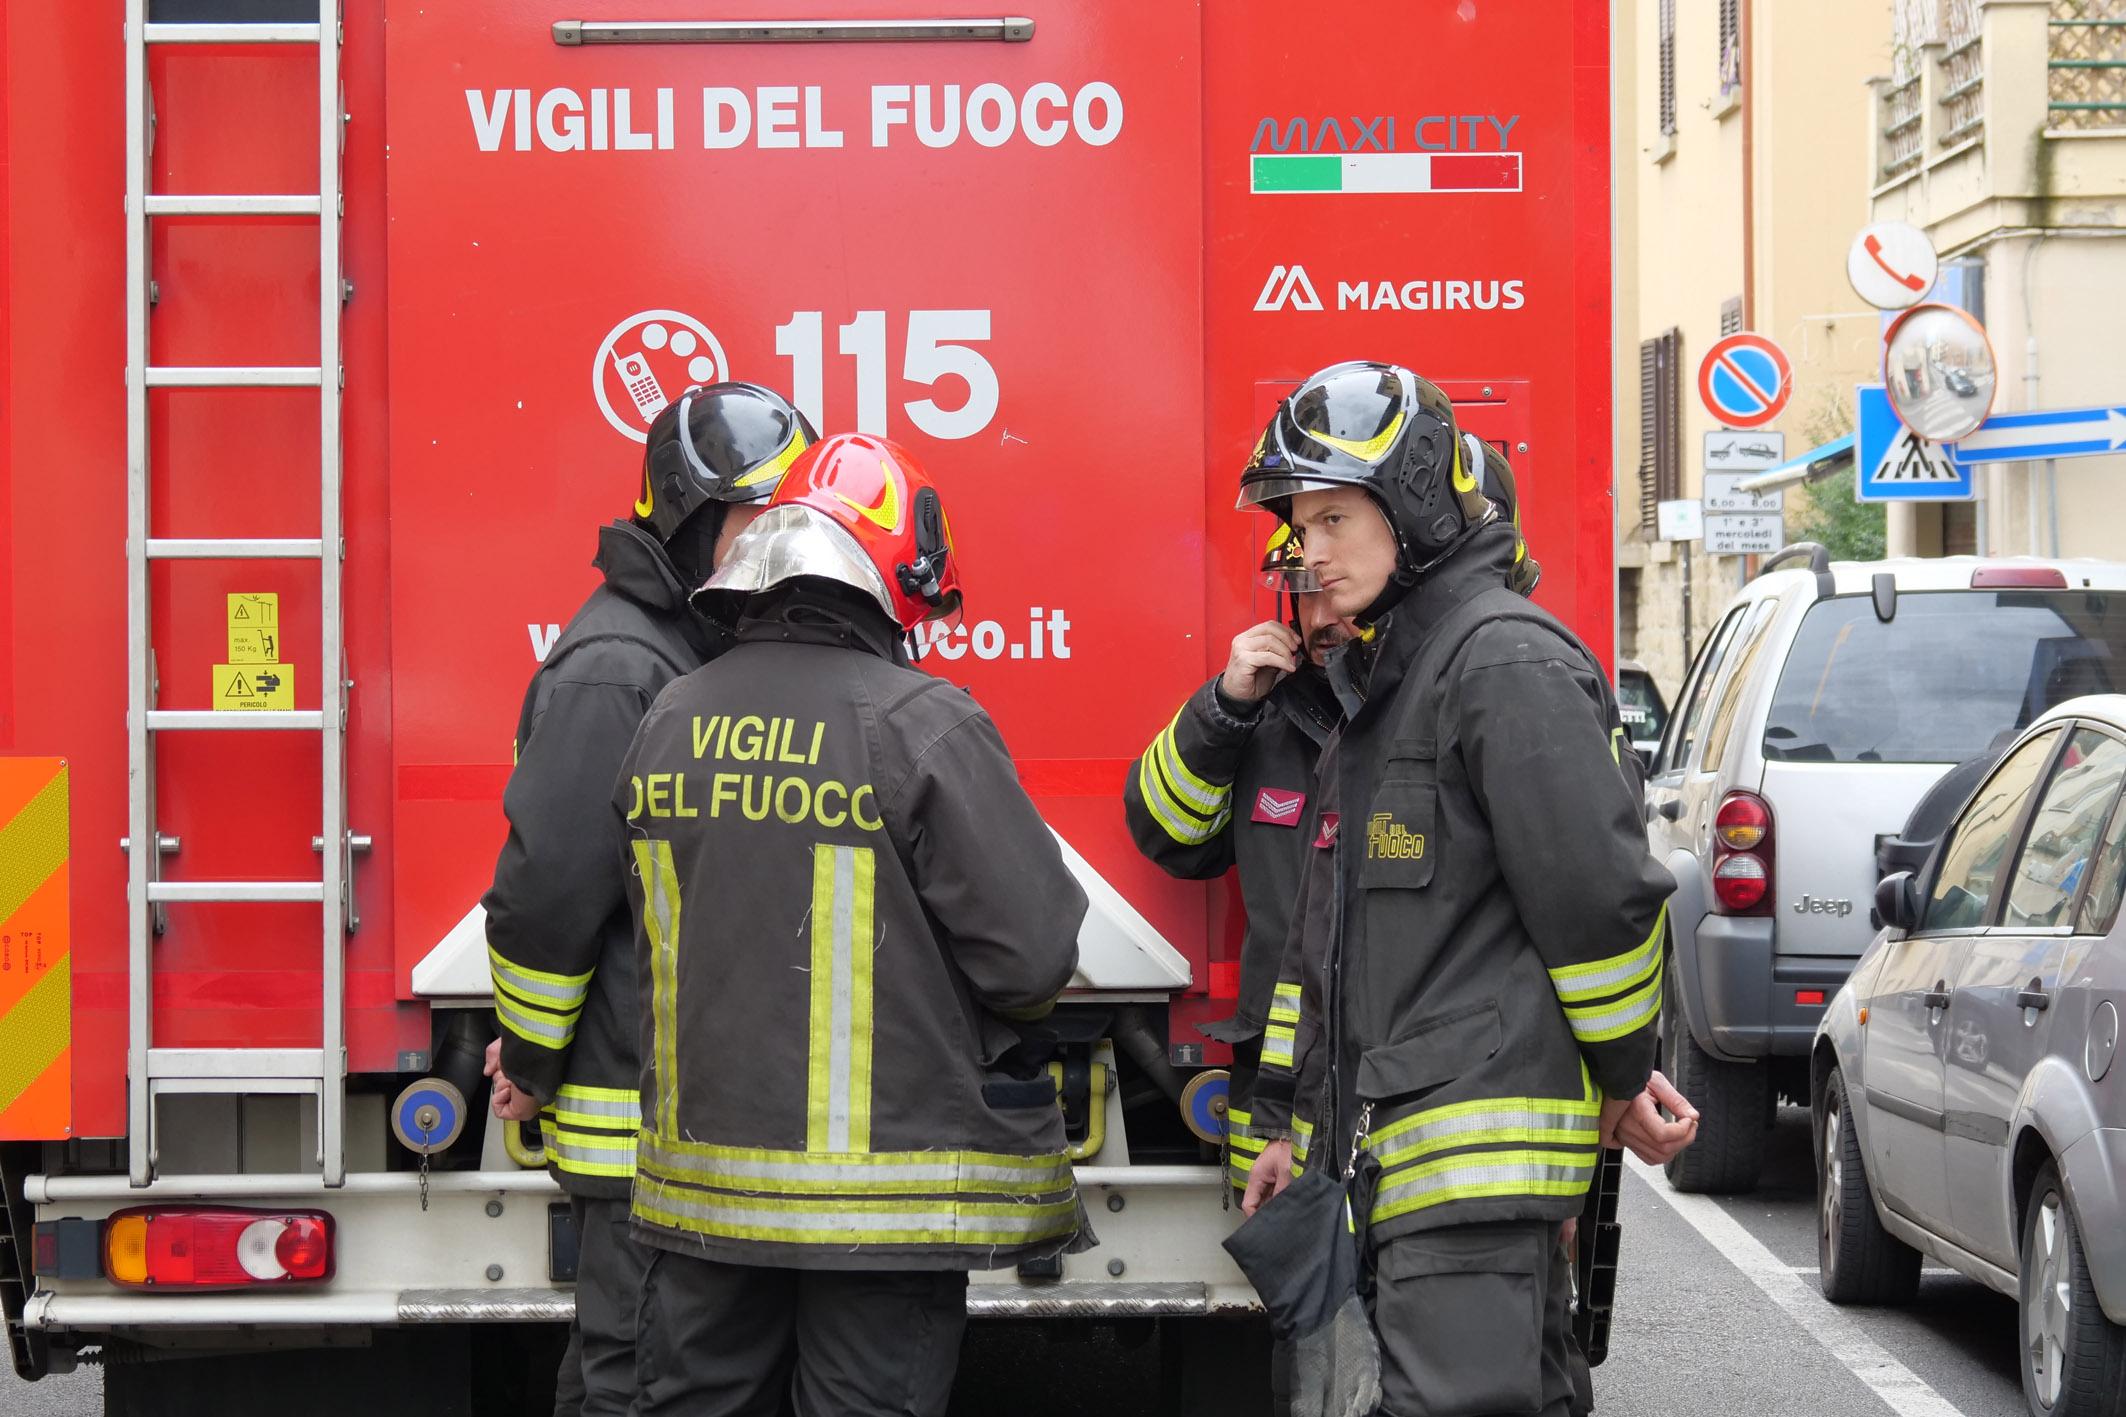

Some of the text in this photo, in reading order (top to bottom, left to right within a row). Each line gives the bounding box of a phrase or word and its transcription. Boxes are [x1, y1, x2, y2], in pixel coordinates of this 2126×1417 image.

[465, 81, 1124, 152] VIGILI DEL FUOCO
[1250, 115, 1521, 152] MAXI CITY
[1337, 280, 1526, 311] MAGIRUS
[775, 309, 1000, 440] 115
[1717, 541, 1770, 549] del mese
[692, 715, 826, 765] VIGILI
[710, 773, 884, 831] FUOCO
[1793, 893, 1853, 918] Jeep
